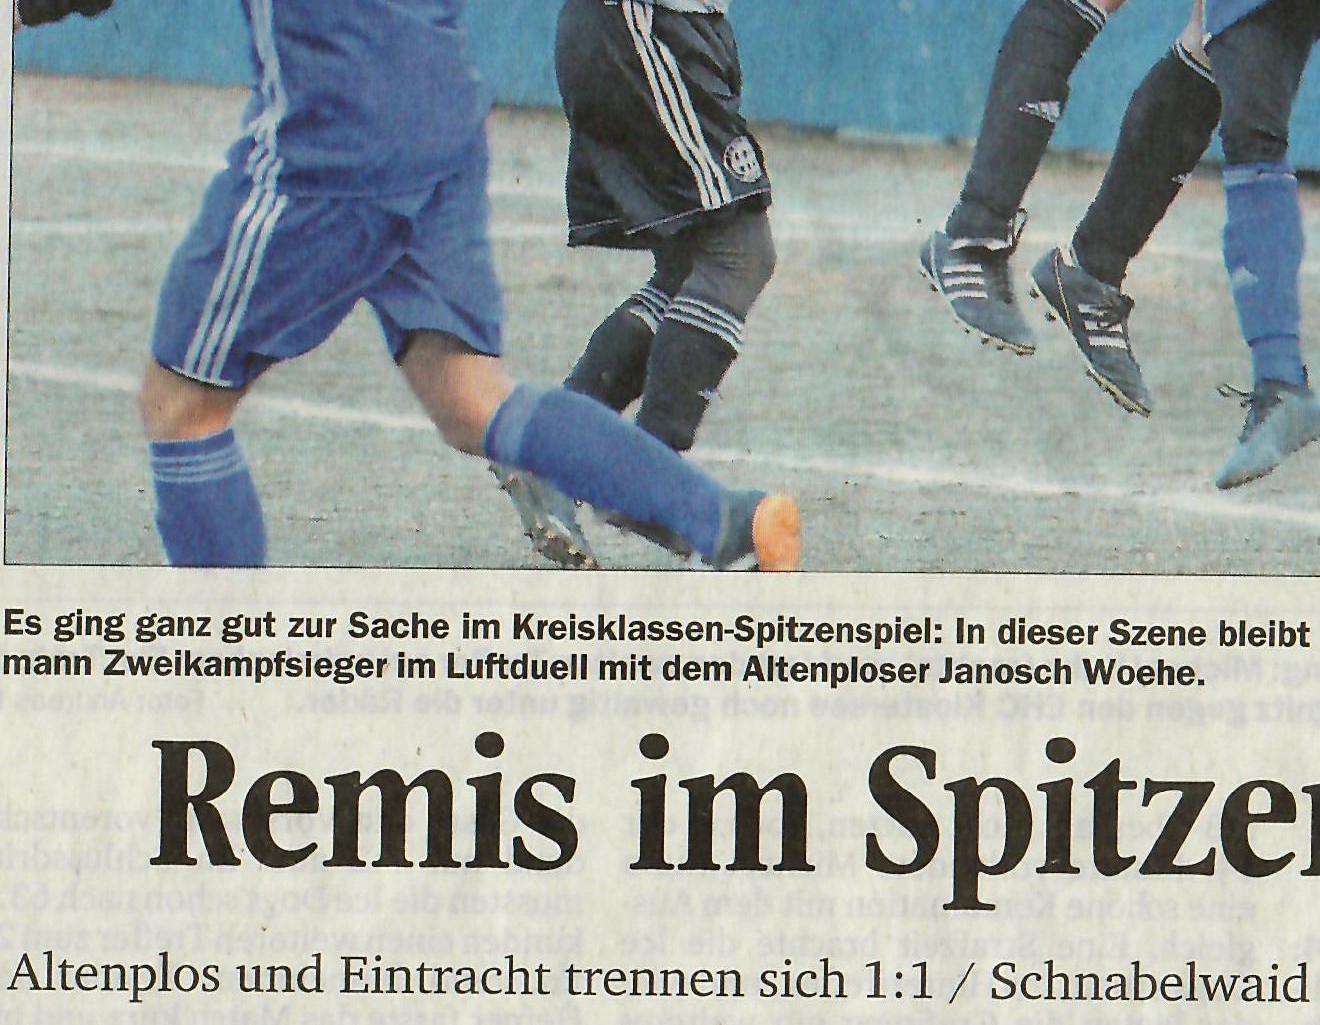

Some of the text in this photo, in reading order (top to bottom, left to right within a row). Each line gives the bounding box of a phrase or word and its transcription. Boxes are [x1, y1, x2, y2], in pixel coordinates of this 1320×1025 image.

[4, 608, 42, 636] Es
[53, 608, 126, 643] ging
[135, 612, 212, 643] ganz
[221, 611, 276, 644] gut
[287, 617, 337, 638] zur
[347, 611, 450, 640] Sache
[462, 612, 501, 640] im
[513, 613, 942, 650] Kreisklassen-Spitzenspiel:
[956, 617, 985, 645] In
[997, 617, 1099, 646] dieser
[1108, 618, 1207, 647] Szene
[1219, 619, 1311, 648] bleibt
[3, 649, 1205, 689] mann Zweikampfsieger im Luftduell mit dem Altenploser Janosch Woehe.
[149, 731, 579, 871] Remis
[629, 733, 816, 872] im
[6, 950, 220, 1003] Altenplos
[235, 952, 324, 994] und
[339, 954, 551, 995] Eintracht
[564, 963, 745, 997] trennen
[759, 957, 848, 998] sich
[865, 960, 933, 999] 1:1
[991, 959, 1310, 1003] Schnabelwaid
